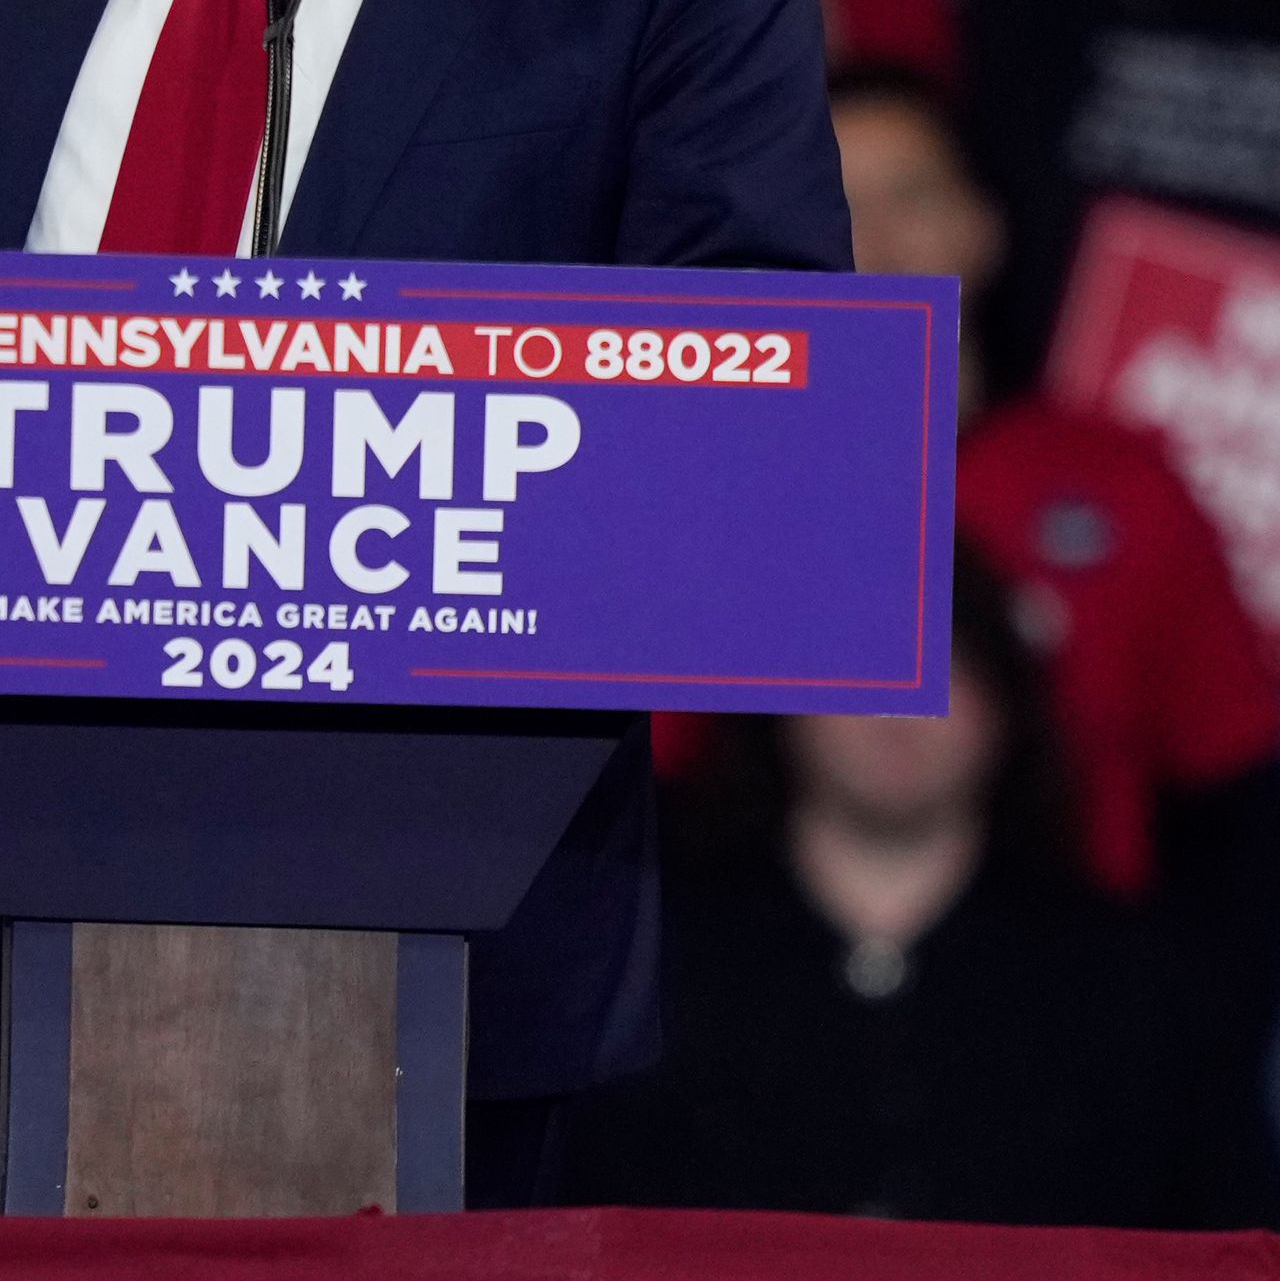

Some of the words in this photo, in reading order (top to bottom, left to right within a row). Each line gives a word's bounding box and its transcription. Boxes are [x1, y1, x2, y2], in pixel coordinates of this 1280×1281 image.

[474, 326, 564, 379] TO
[583, 329, 793, 385] 88022
[14, 496, 506, 597] VANCE
[96, 597, 264, 629] AMERICA
[276, 602, 397, 632] GREAT
[407, 606, 538, 636] AGAIN!
[161, 636, 355, 693] 2024
